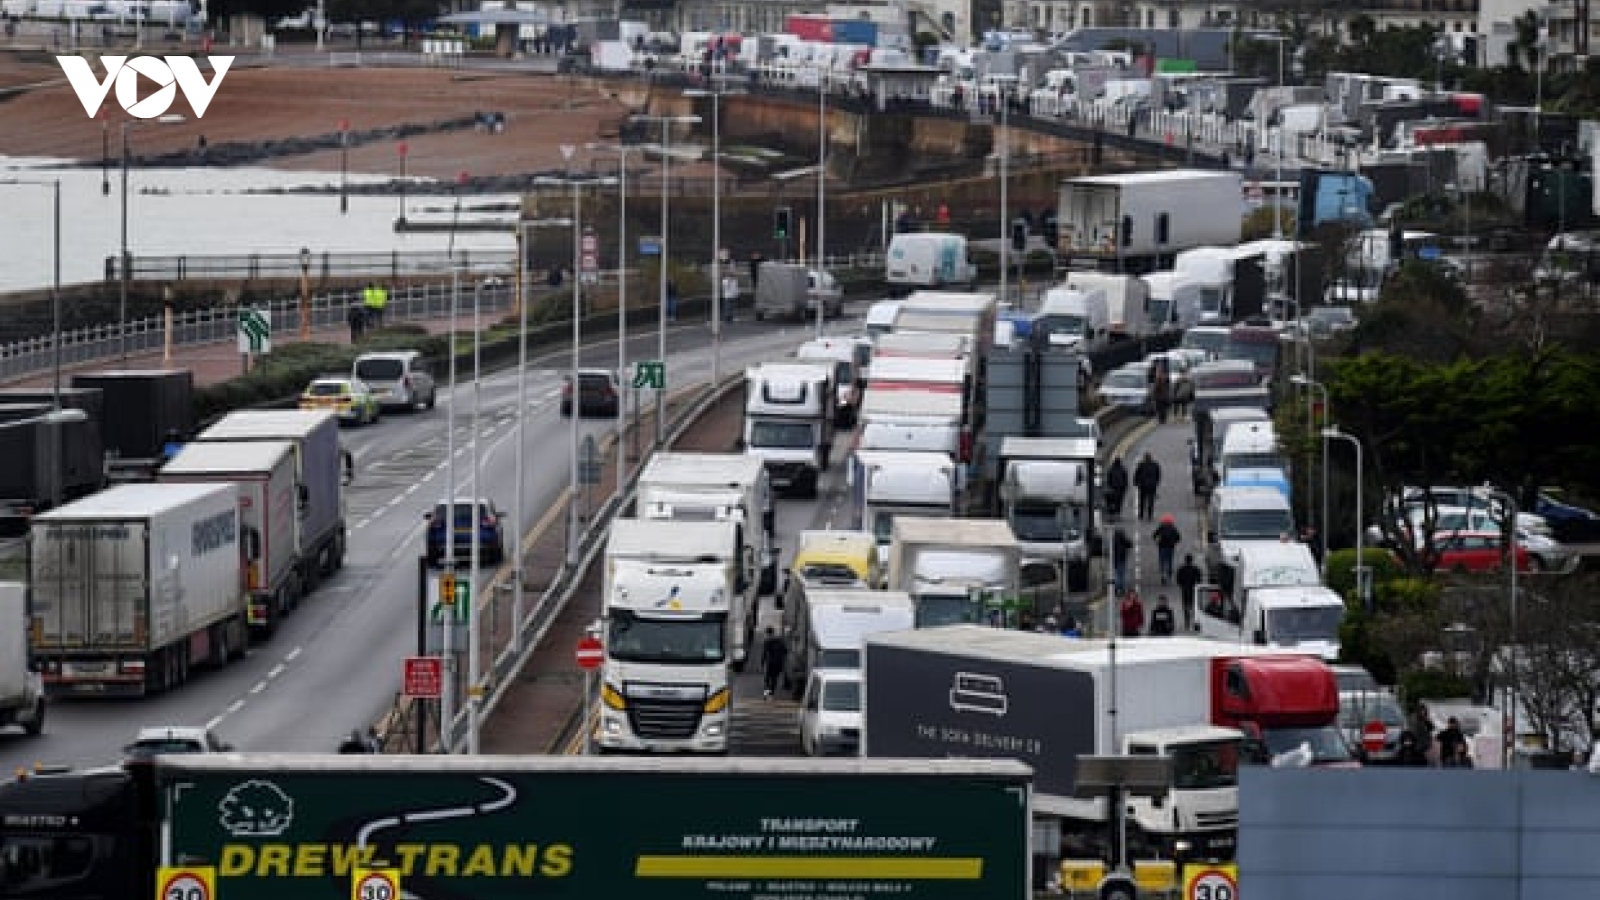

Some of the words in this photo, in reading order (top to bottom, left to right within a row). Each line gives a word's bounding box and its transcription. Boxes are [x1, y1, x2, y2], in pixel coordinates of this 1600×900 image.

[761, 818, 859, 833] TRANSPORT
[169, 886, 203, 900] 30
[1196, 885, 1232, 900] 30
